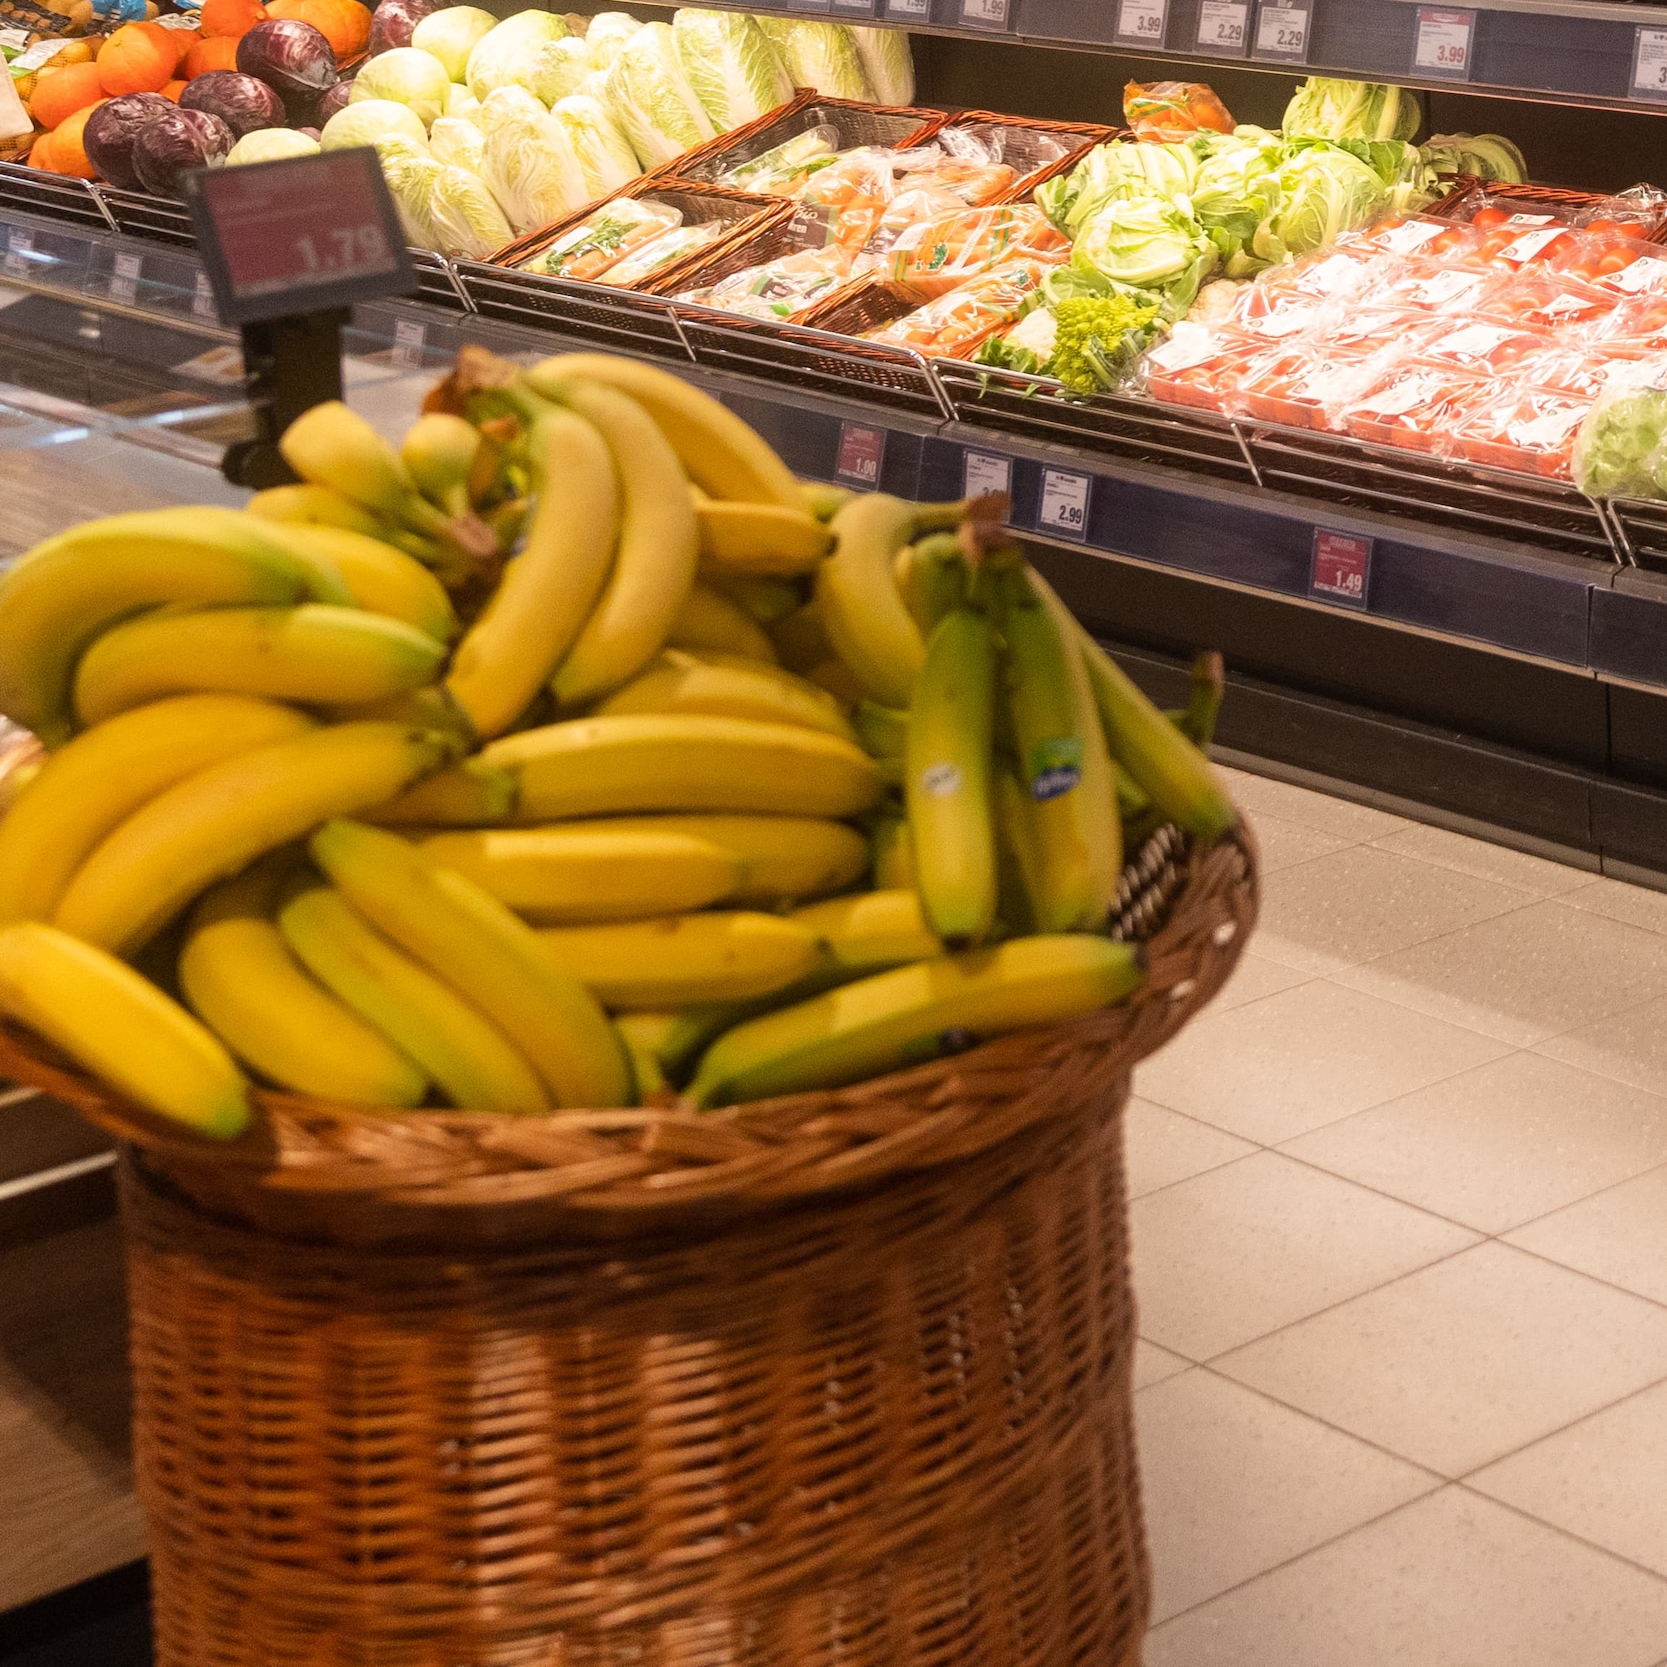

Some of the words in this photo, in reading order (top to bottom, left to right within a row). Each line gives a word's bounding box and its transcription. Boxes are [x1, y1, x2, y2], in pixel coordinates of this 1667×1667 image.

[1138, 16, 1160, 32] 3.99
[1216, 23, 1242, 40] 2.29
[1277, 29, 1303, 46] 2.29
[1438, 45, 1465, 63] 3.99
[297, 225, 385, 272] 1.79
[856, 458, 877, 476] 1.00
[1060, 505, 1083, 525] 2.99
[1335, 570, 1362, 592] 1.49
